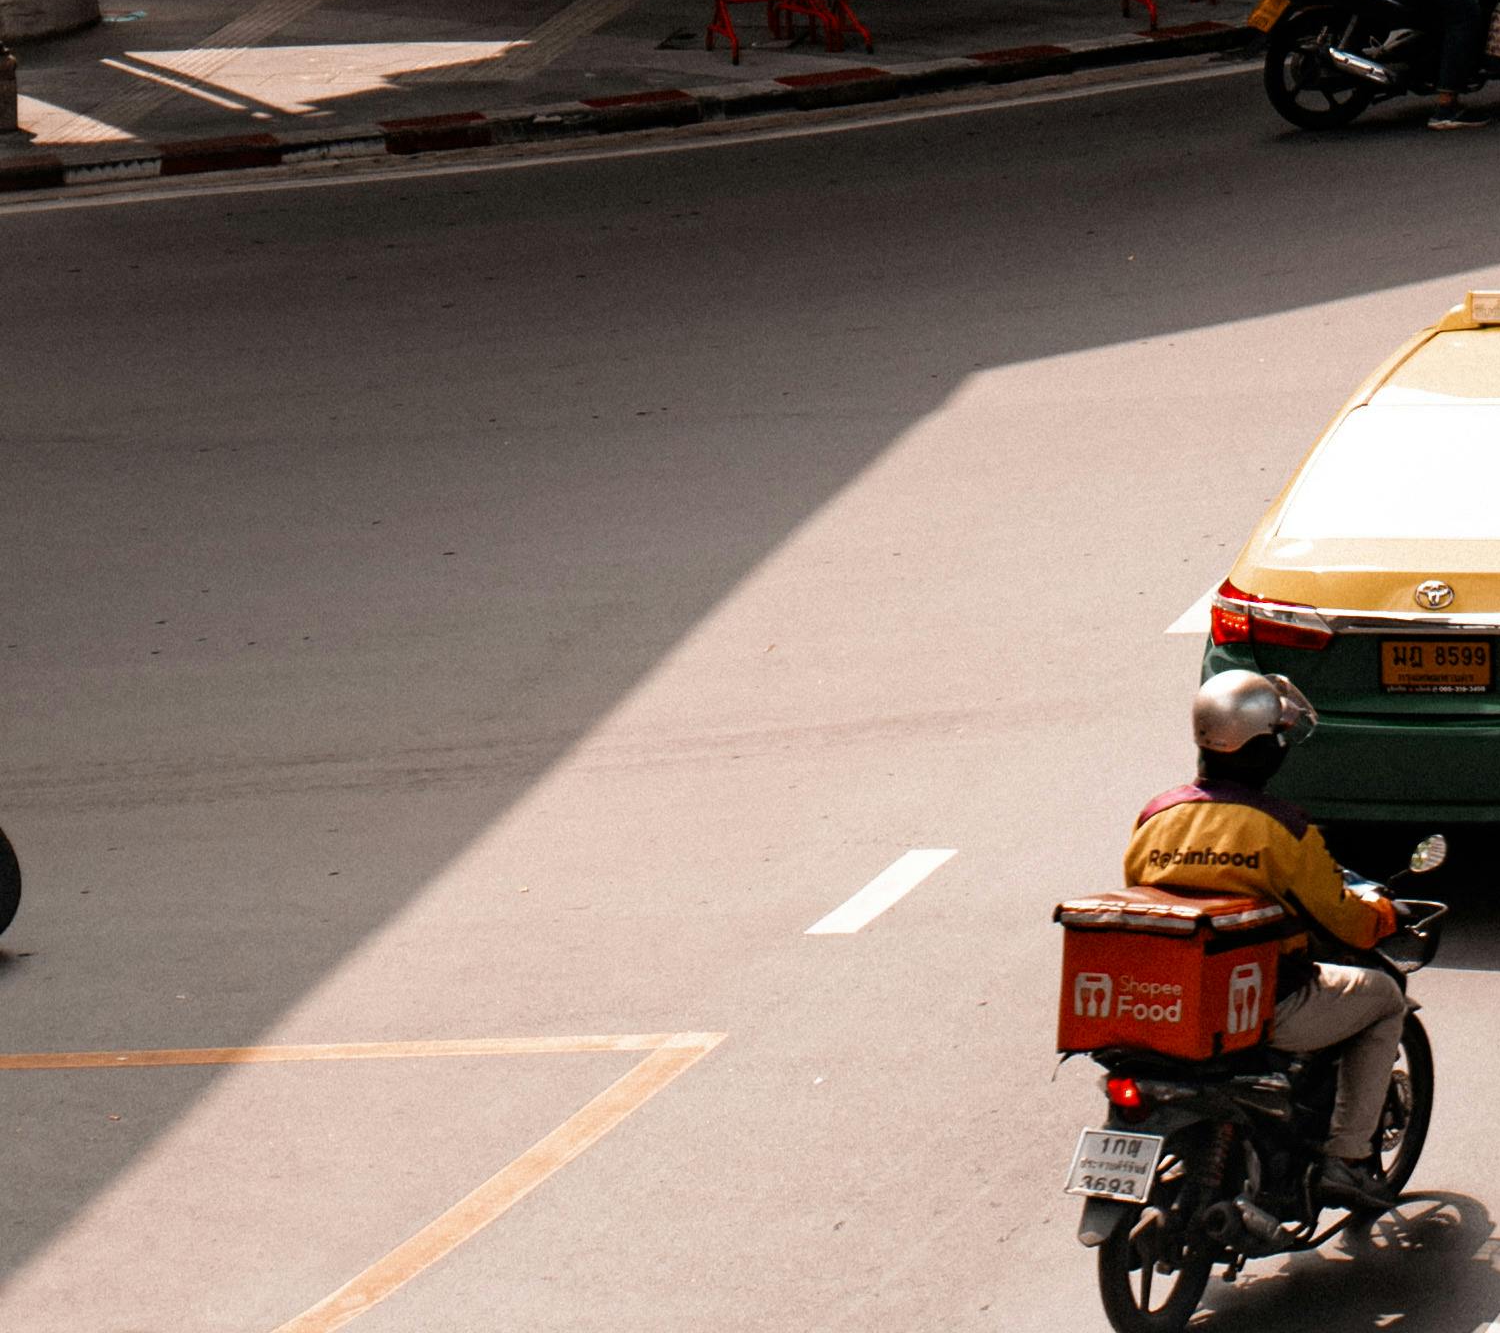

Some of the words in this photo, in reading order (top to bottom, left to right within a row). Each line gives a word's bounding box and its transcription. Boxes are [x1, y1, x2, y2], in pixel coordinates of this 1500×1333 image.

[1434, 645, 1487, 668] 8599
[1117, 974, 1184, 1001] Shopee
[1116, 994, 1183, 1024] Food
[1082, 1176, 1138, 1196] 3693
